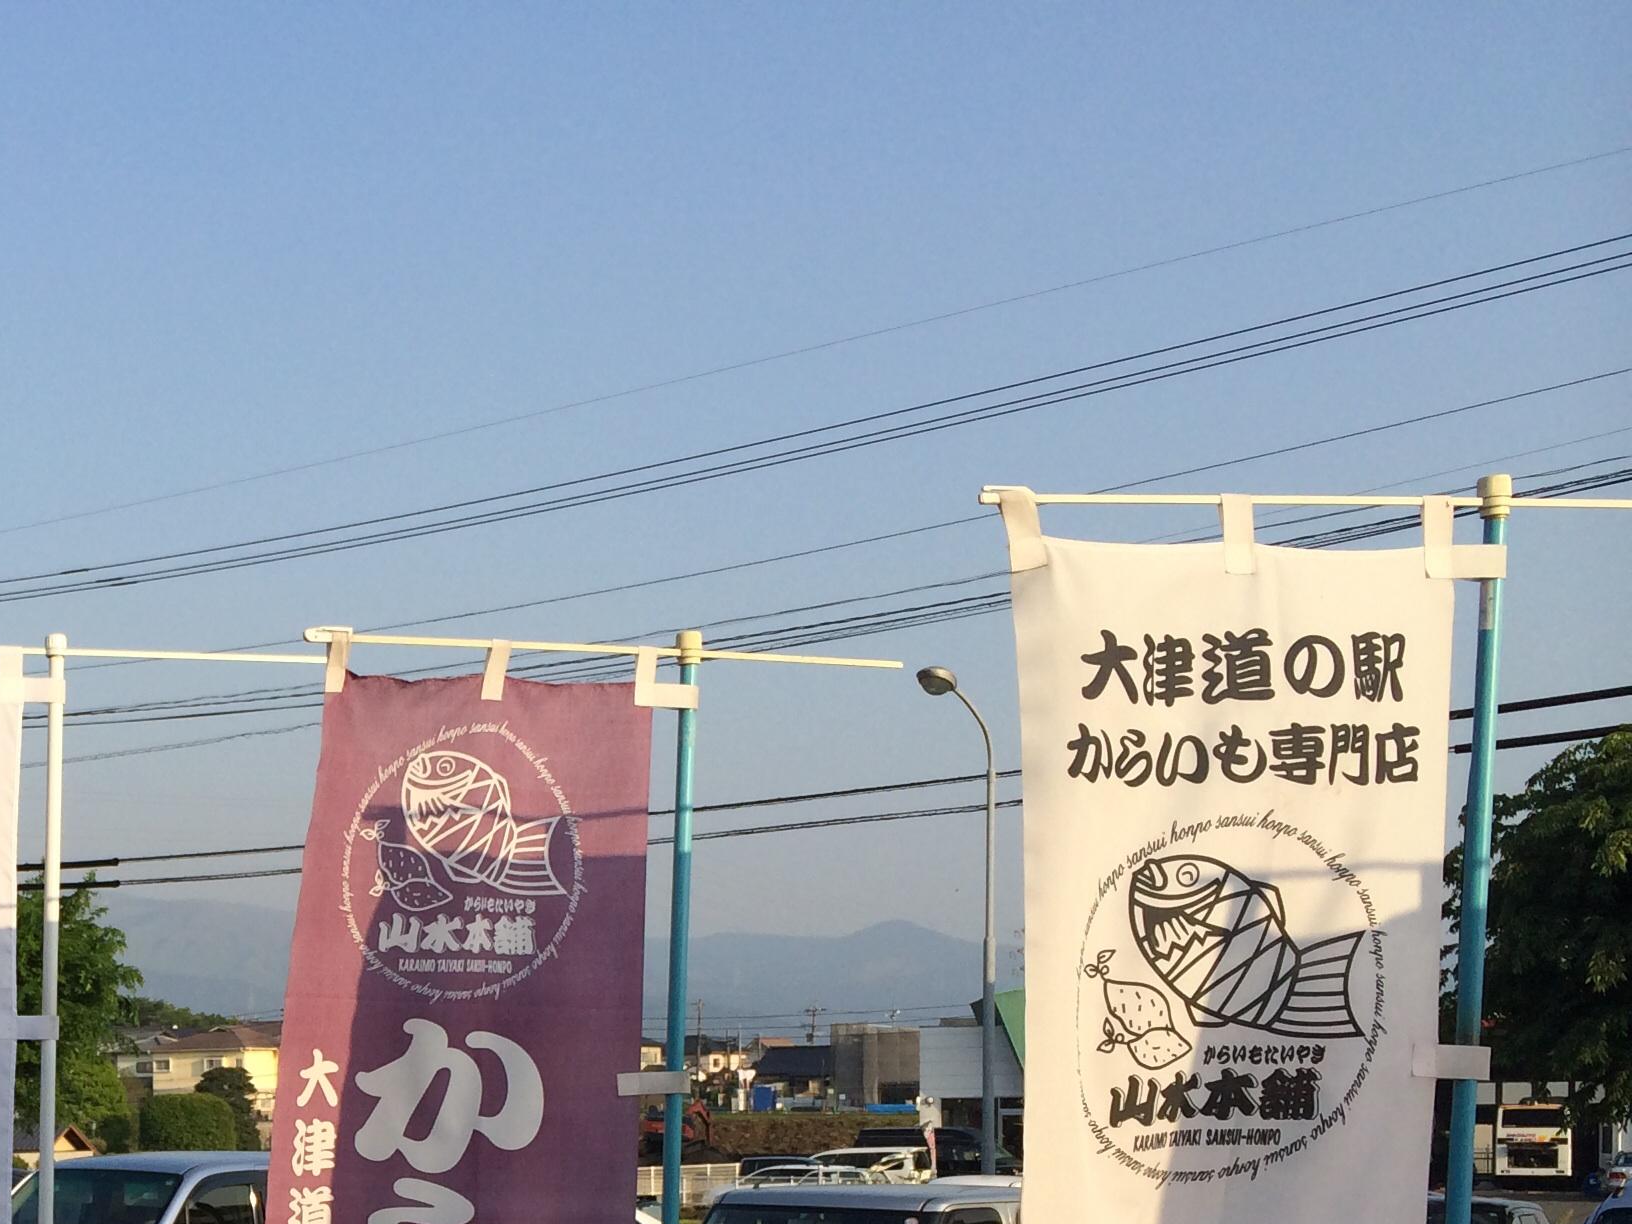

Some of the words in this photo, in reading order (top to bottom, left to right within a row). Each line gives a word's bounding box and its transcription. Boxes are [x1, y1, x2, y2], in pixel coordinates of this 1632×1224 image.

[1081, 628, 1406, 708] 大津道の駅
[1067, 722, 1421, 788] からいも専門店
[398, 958, 436, 972] KARAIMO
[437, 959, 465, 973] TAIYAKI
[1203, 1044, 1326, 1065] からいもたいやき
[1133, 1130, 1168, 1152] KARAIMO
[1169, 1129, 1202, 1147] TAIYAKI
[1206, 1128, 1281, 1146] SANSUI-HONPO
